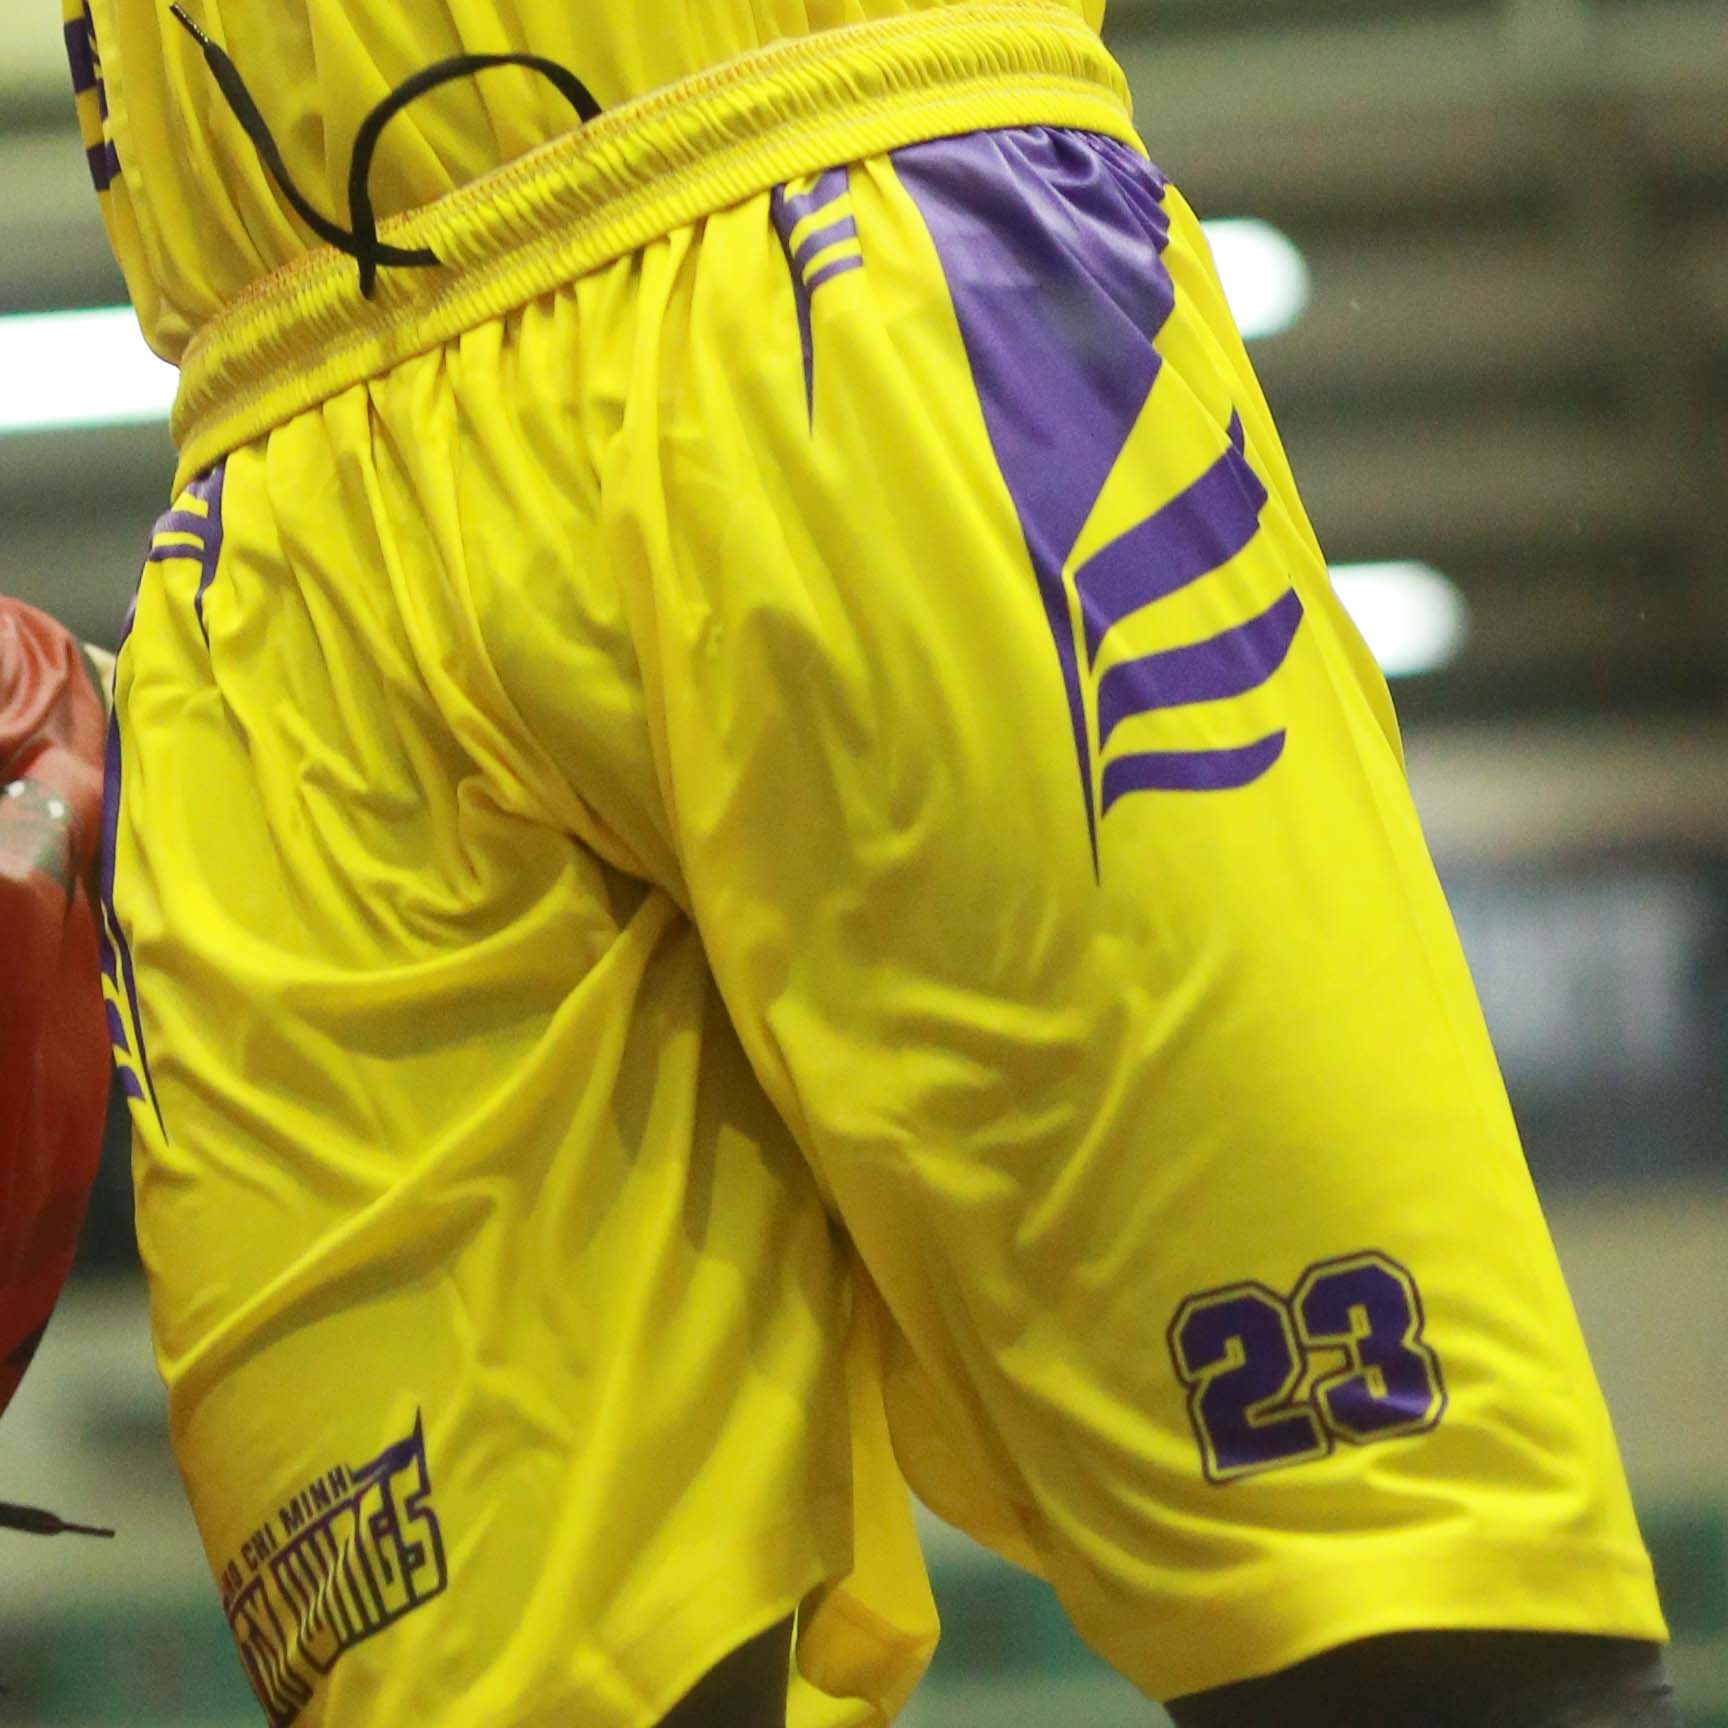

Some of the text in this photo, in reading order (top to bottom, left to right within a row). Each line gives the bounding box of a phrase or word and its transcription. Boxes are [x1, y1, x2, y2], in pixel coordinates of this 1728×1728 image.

[1166, 1249, 1448, 1485] 23
[241, 1520, 282, 1574] CHI
[278, 1462, 354, 1538] MINH
[268, 1406, 449, 1675] WINGS
